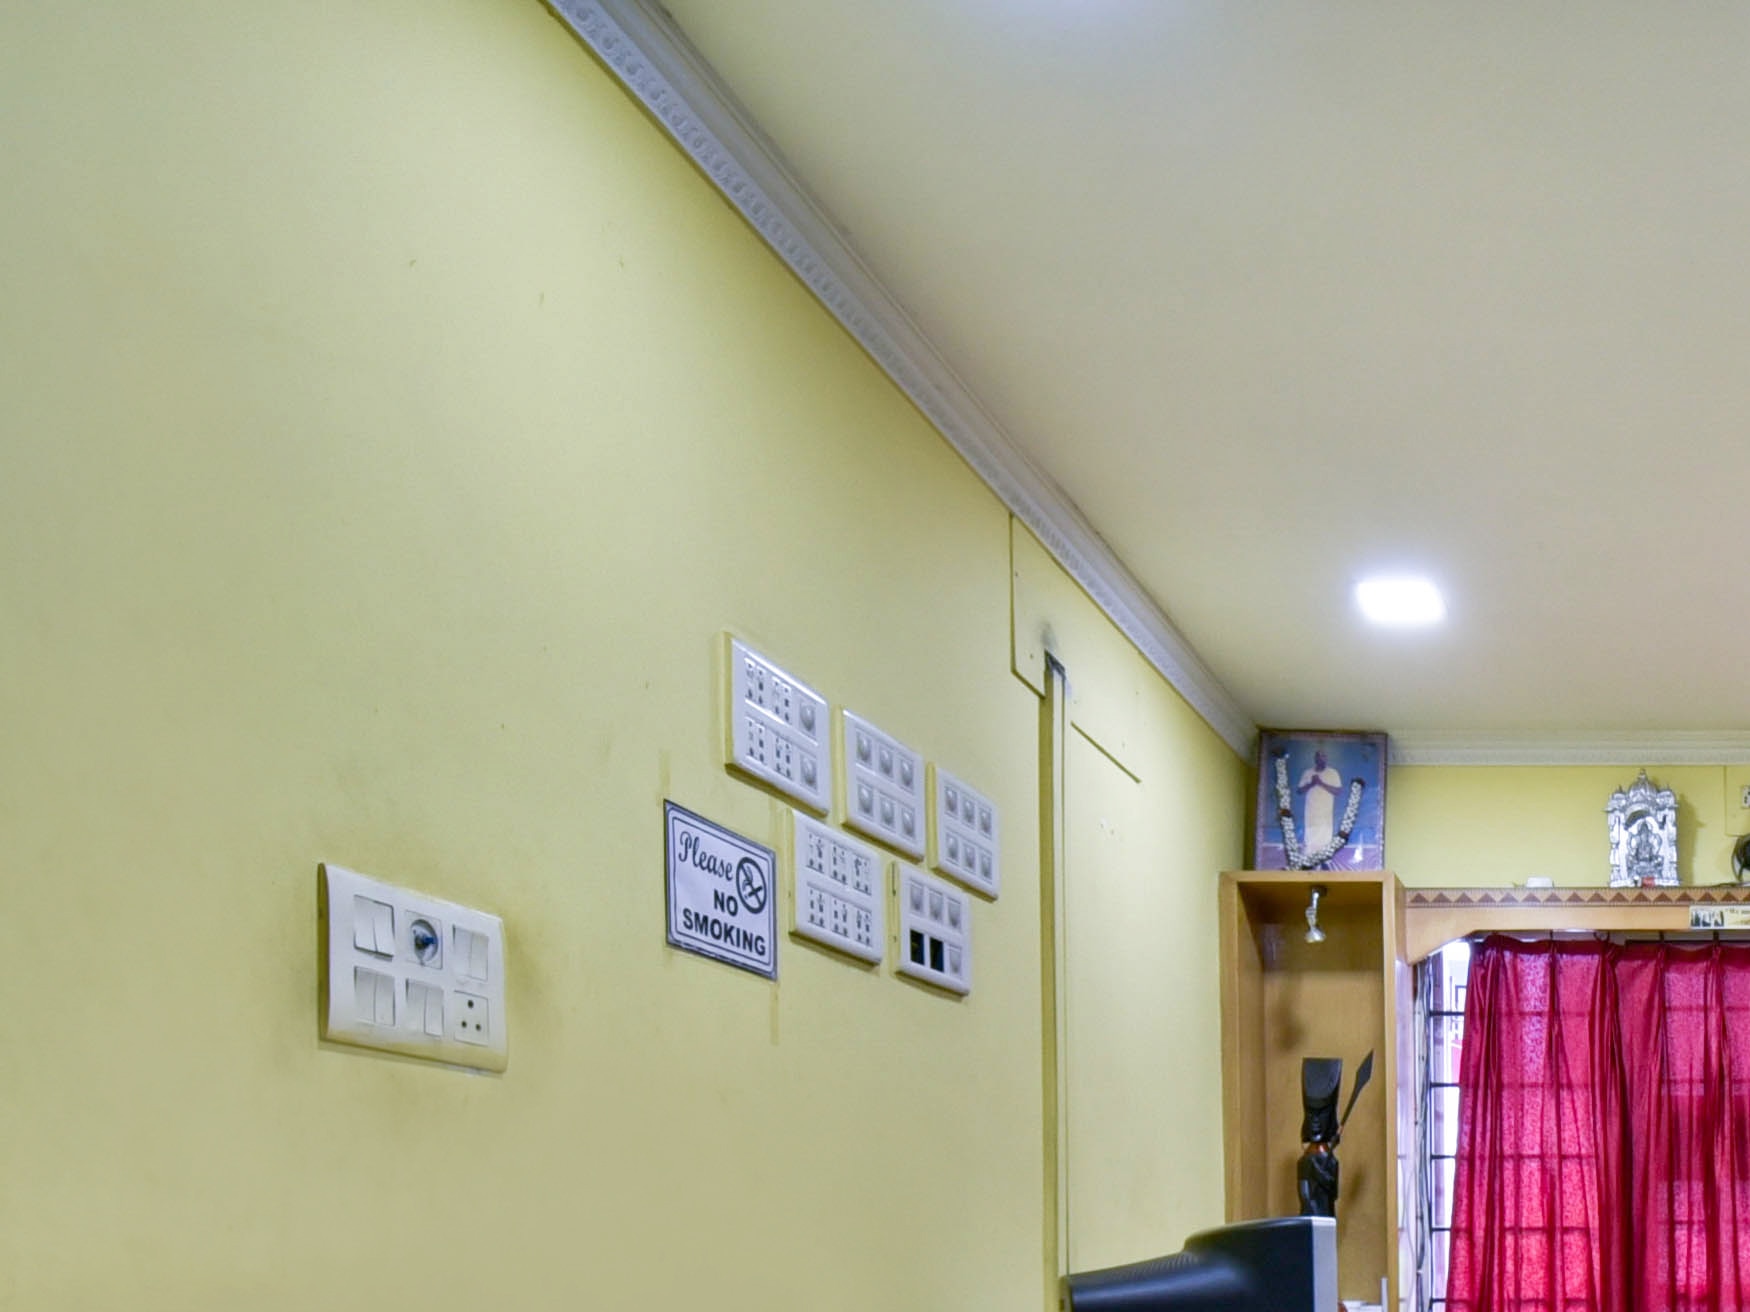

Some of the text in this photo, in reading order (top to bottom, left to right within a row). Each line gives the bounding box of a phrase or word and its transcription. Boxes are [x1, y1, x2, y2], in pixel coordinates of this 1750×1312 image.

[678, 830, 733, 882] Please
[713, 888, 739, 917] NO
[682, 907, 767, 956] SMOKING
